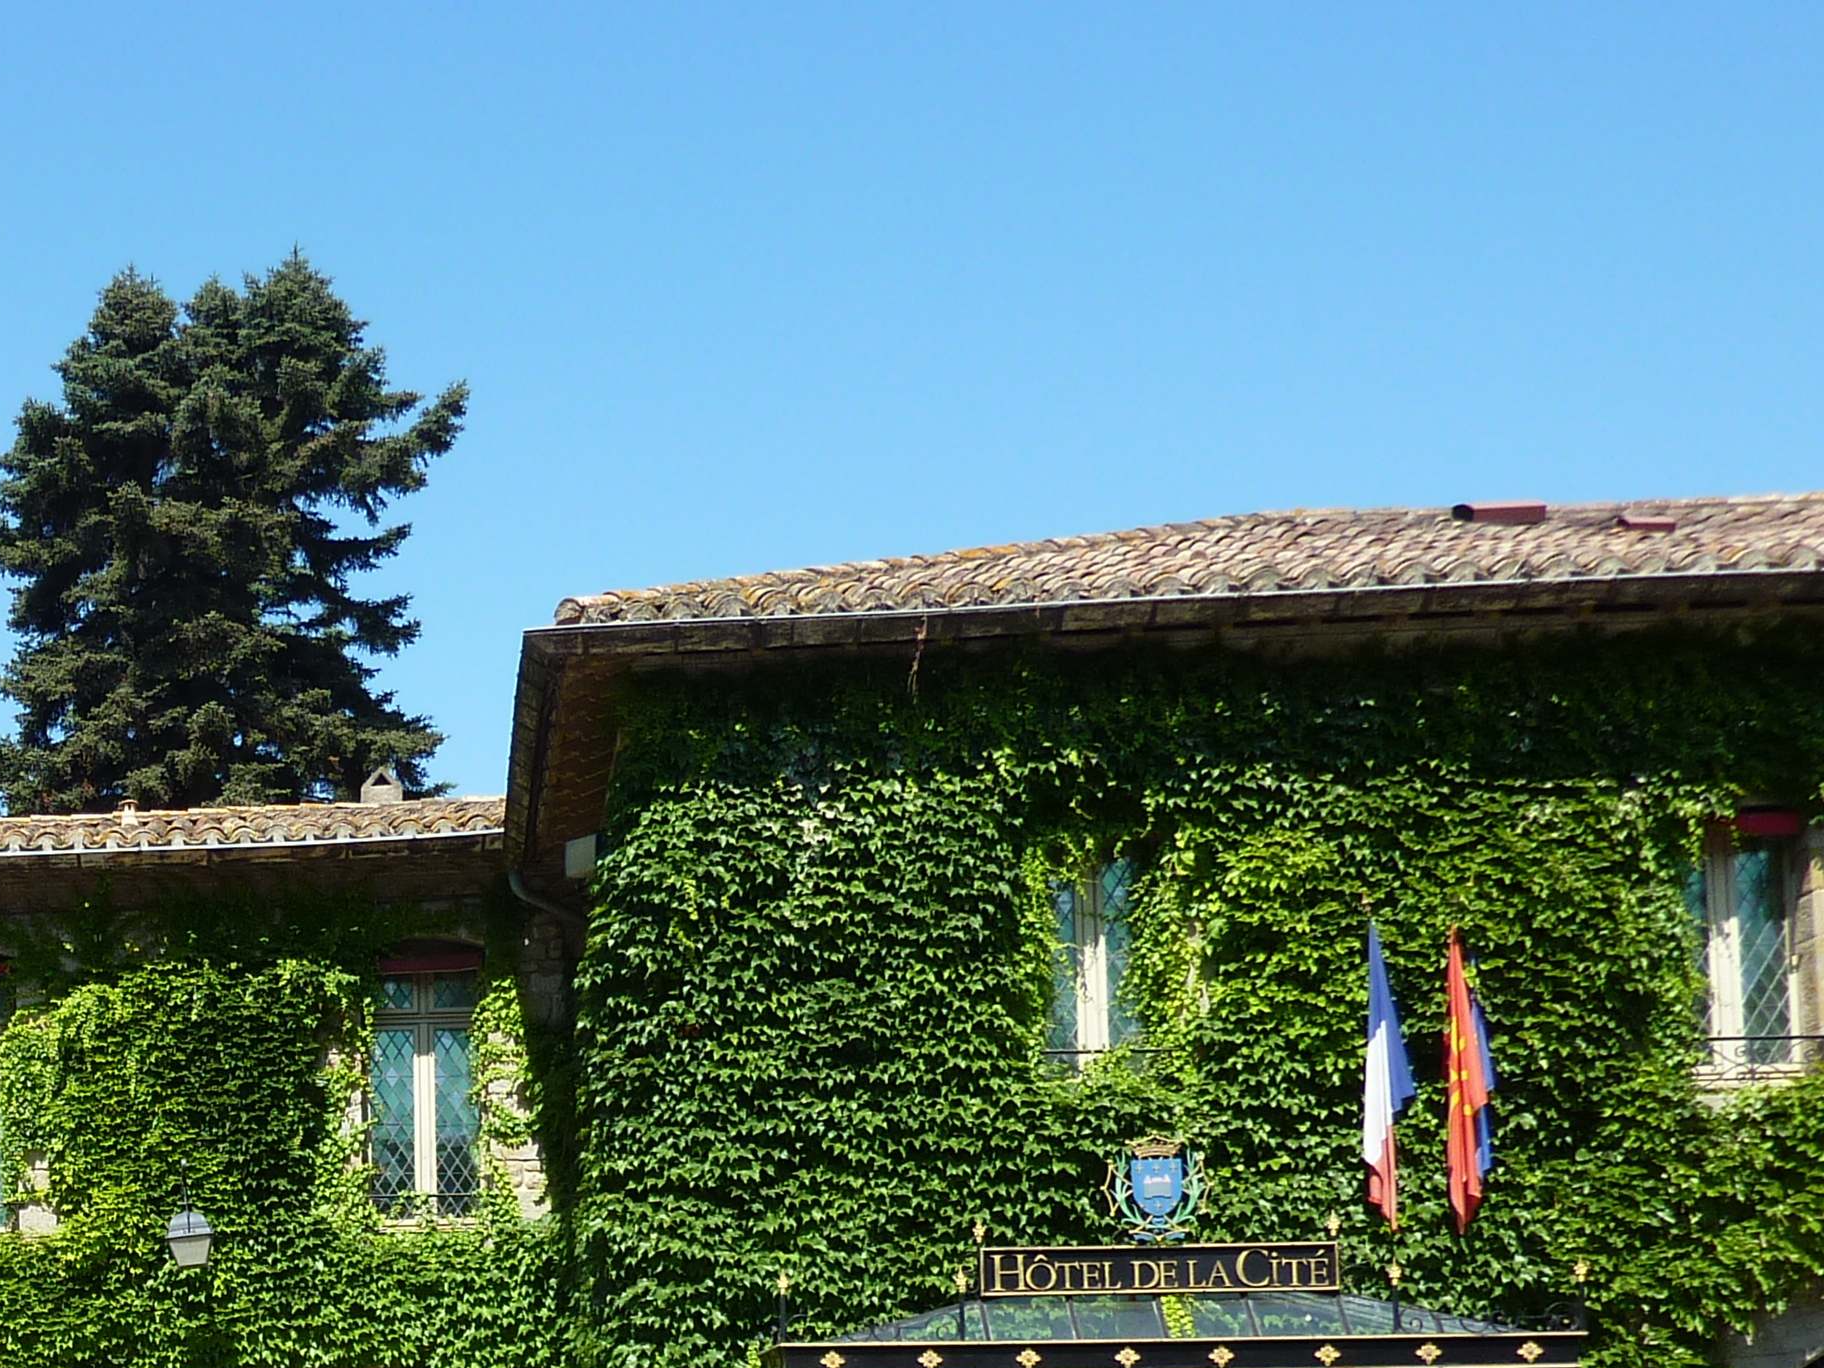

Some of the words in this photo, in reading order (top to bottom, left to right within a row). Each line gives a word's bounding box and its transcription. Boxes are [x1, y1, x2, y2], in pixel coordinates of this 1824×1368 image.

[990, 1253, 1122, 1291] HÔTEL
[1129, 1259, 1179, 1289] DE
[1186, 1258, 1234, 1289] LA
